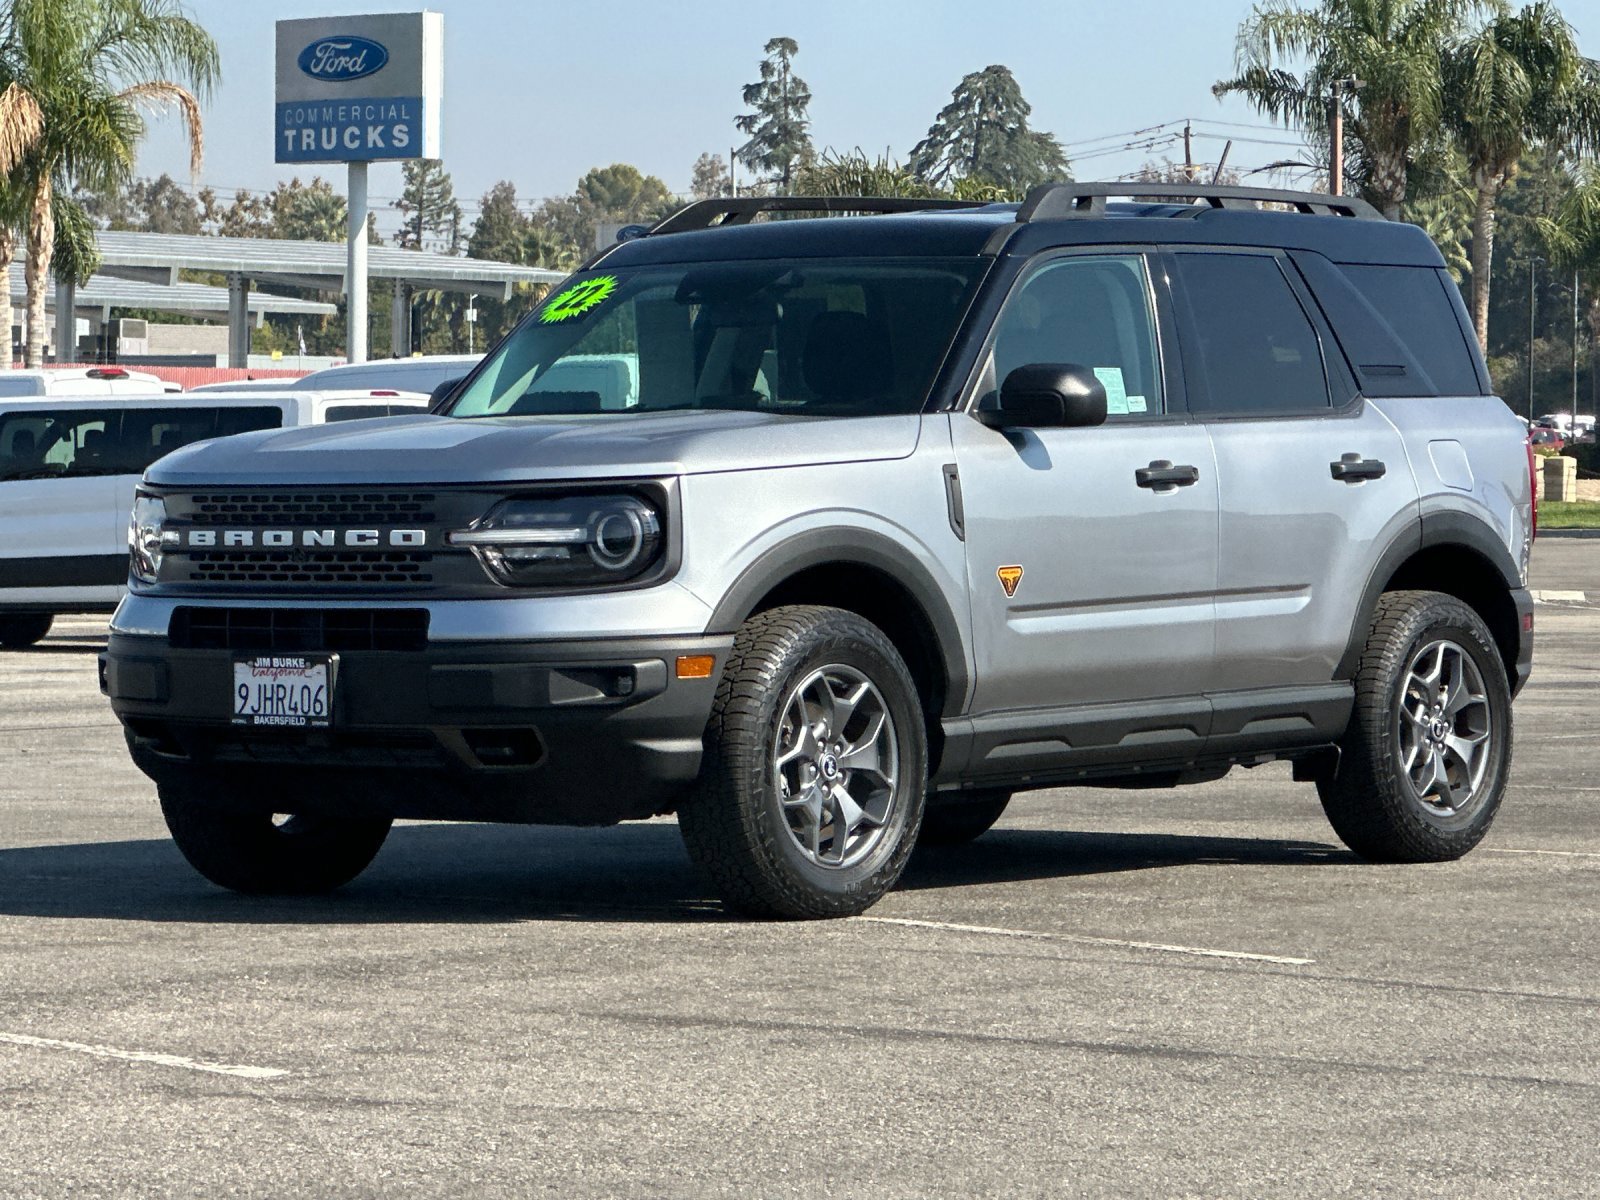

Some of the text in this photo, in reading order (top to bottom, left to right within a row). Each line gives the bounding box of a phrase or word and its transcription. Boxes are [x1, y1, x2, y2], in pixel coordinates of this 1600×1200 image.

[310, 42, 367, 73] Ford
[285, 104, 410, 125] COMMERCIAL
[284, 124, 409, 151] TRUCKS
[553, 283, 606, 312] 22
[188, 529, 426, 546] BRONCO
[254, 657, 305, 668] JIM BURKE
[238, 683, 324, 716] 9JHR406
[254, 716, 306, 726] BAKERSFIELD
